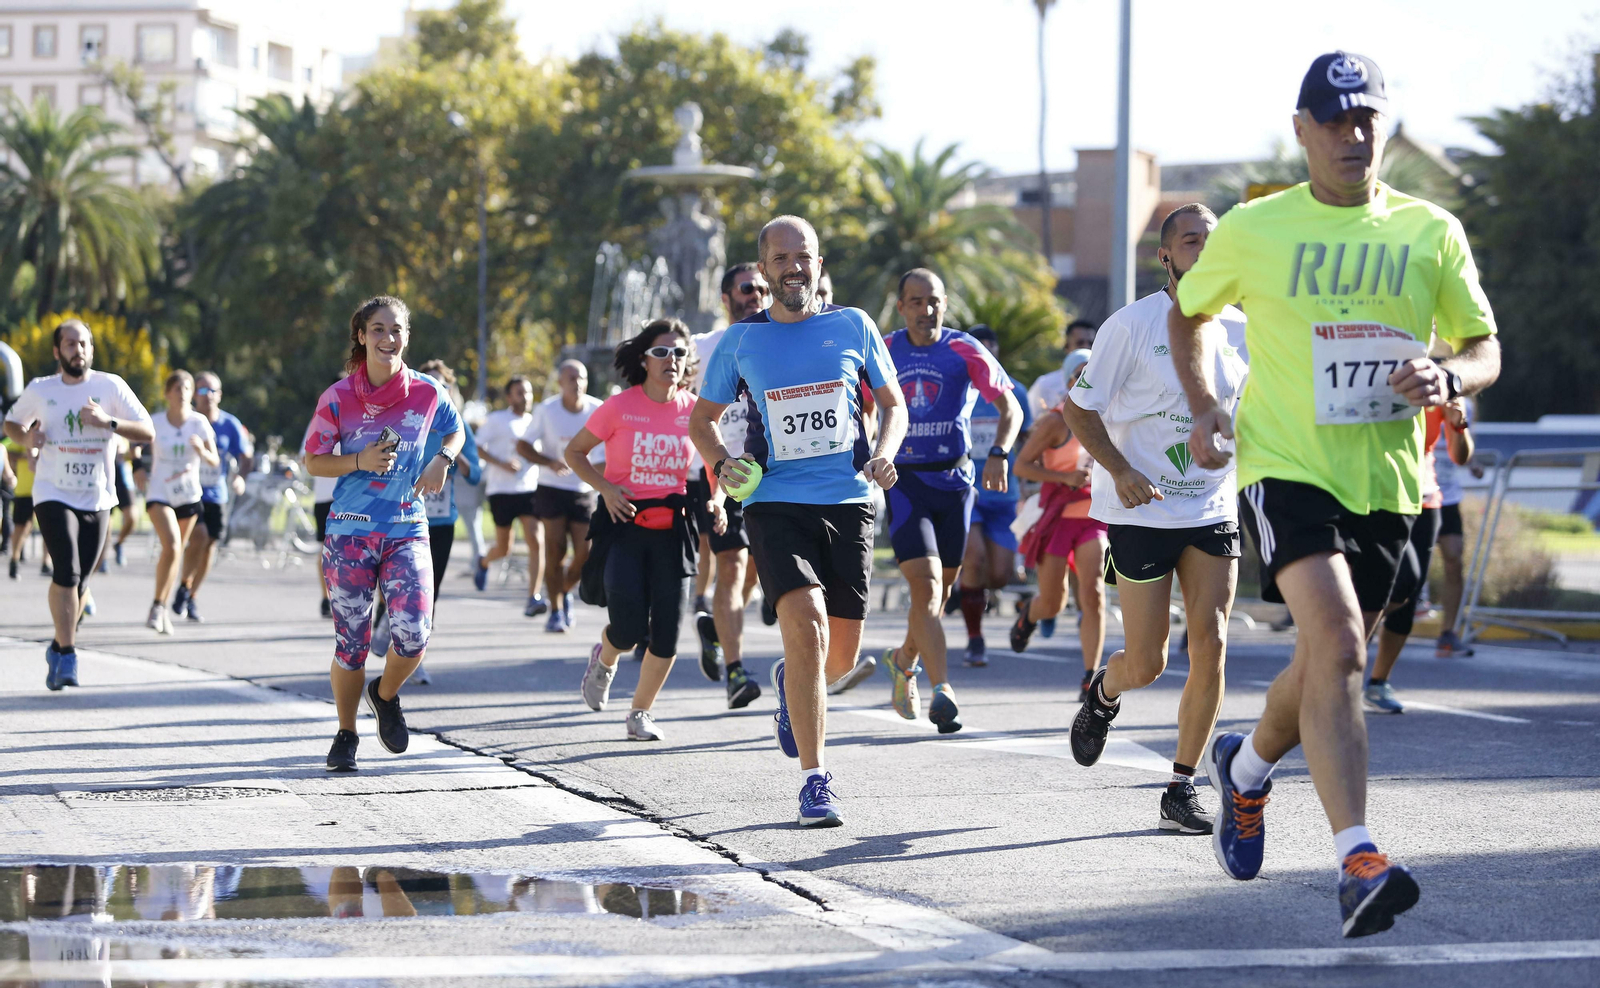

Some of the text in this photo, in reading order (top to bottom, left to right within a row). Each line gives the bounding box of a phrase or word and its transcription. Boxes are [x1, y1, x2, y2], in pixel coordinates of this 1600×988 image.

[1286, 242, 1410, 297] RUN
[1315, 325, 1335, 340] 41
[1336, 324, 1382, 333] CARRERA
[1325, 359, 1412, 388] 1777
[767, 381, 845, 402] 41 CARRERA URBANA
[783, 393, 803, 401] CIUDAD
[811, 388, 834, 396] MALAGA
[622, 413, 650, 423] OYSHO
[783, 408, 838, 435] 3786
[1170, 413, 1194, 424] CARRE
[633, 431, 687, 457] HOY
[65, 461, 96, 476] 1537
[630, 471, 679, 487] CHICAS
[1160, 475, 1206, 488] Fundación
